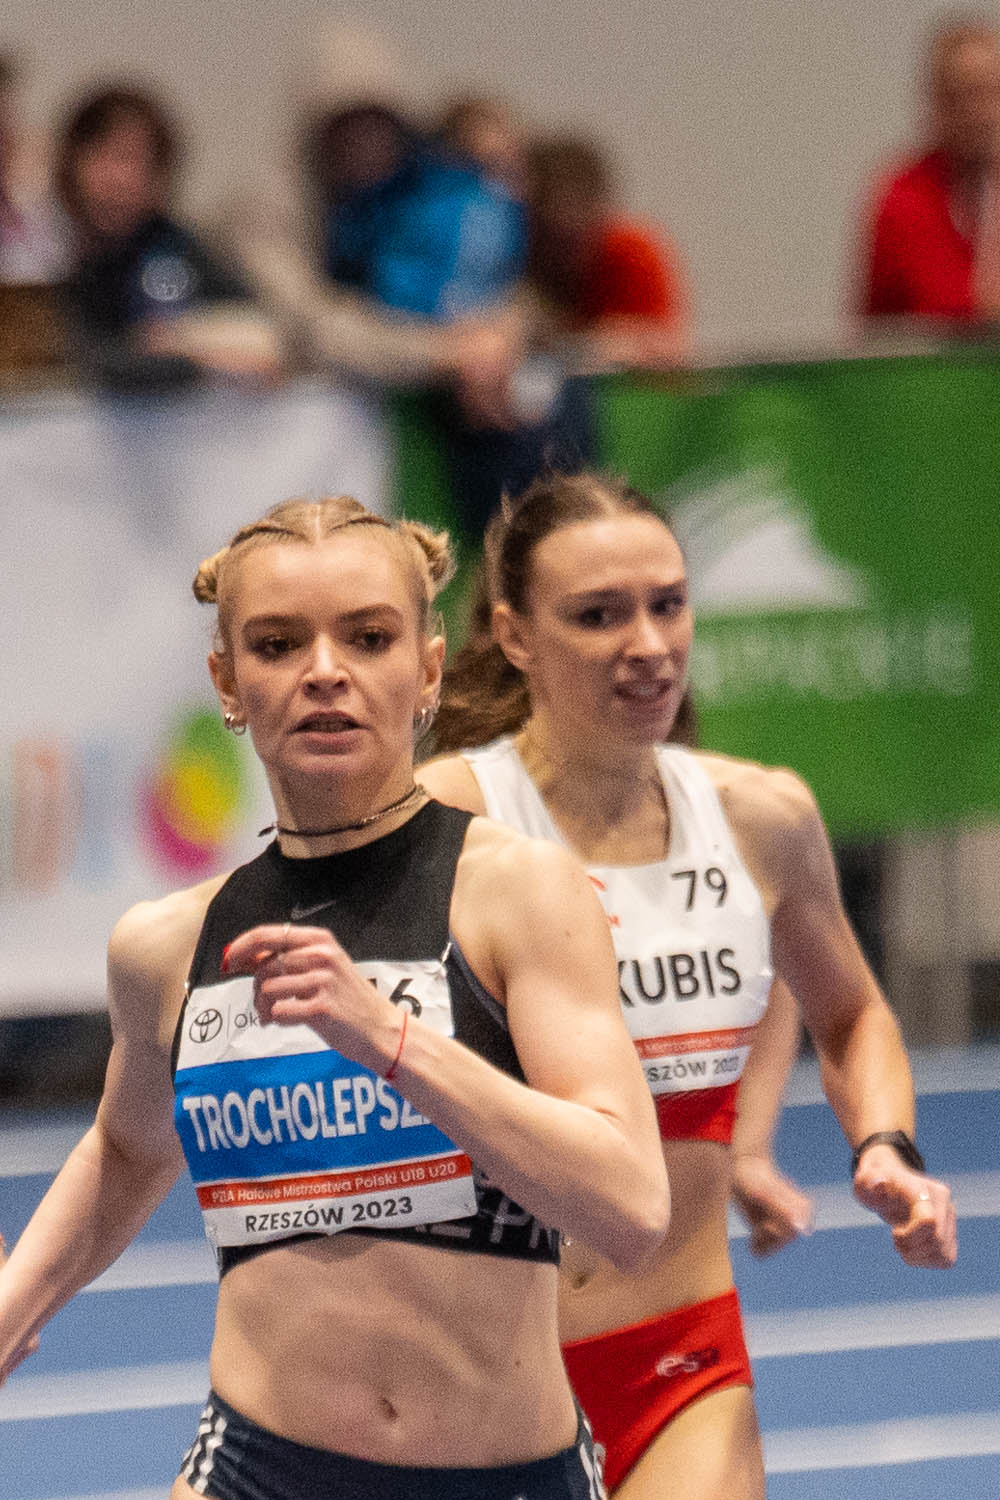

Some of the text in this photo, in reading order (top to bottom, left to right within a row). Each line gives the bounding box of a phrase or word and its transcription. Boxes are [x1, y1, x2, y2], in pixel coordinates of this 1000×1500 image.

[671, 866, 728, 912] 79
[367, 976, 423, 1019] 6
[182, 1074, 433, 1153] TROCHOLEPSZ
[355, 1170, 398, 1190] Polski
[400, 1167, 426, 1183] U18
[429, 1160, 457, 1178] U20
[245, 1204, 344, 1233] RZESZÓW
[351, 1196, 414, 1223] 2023
